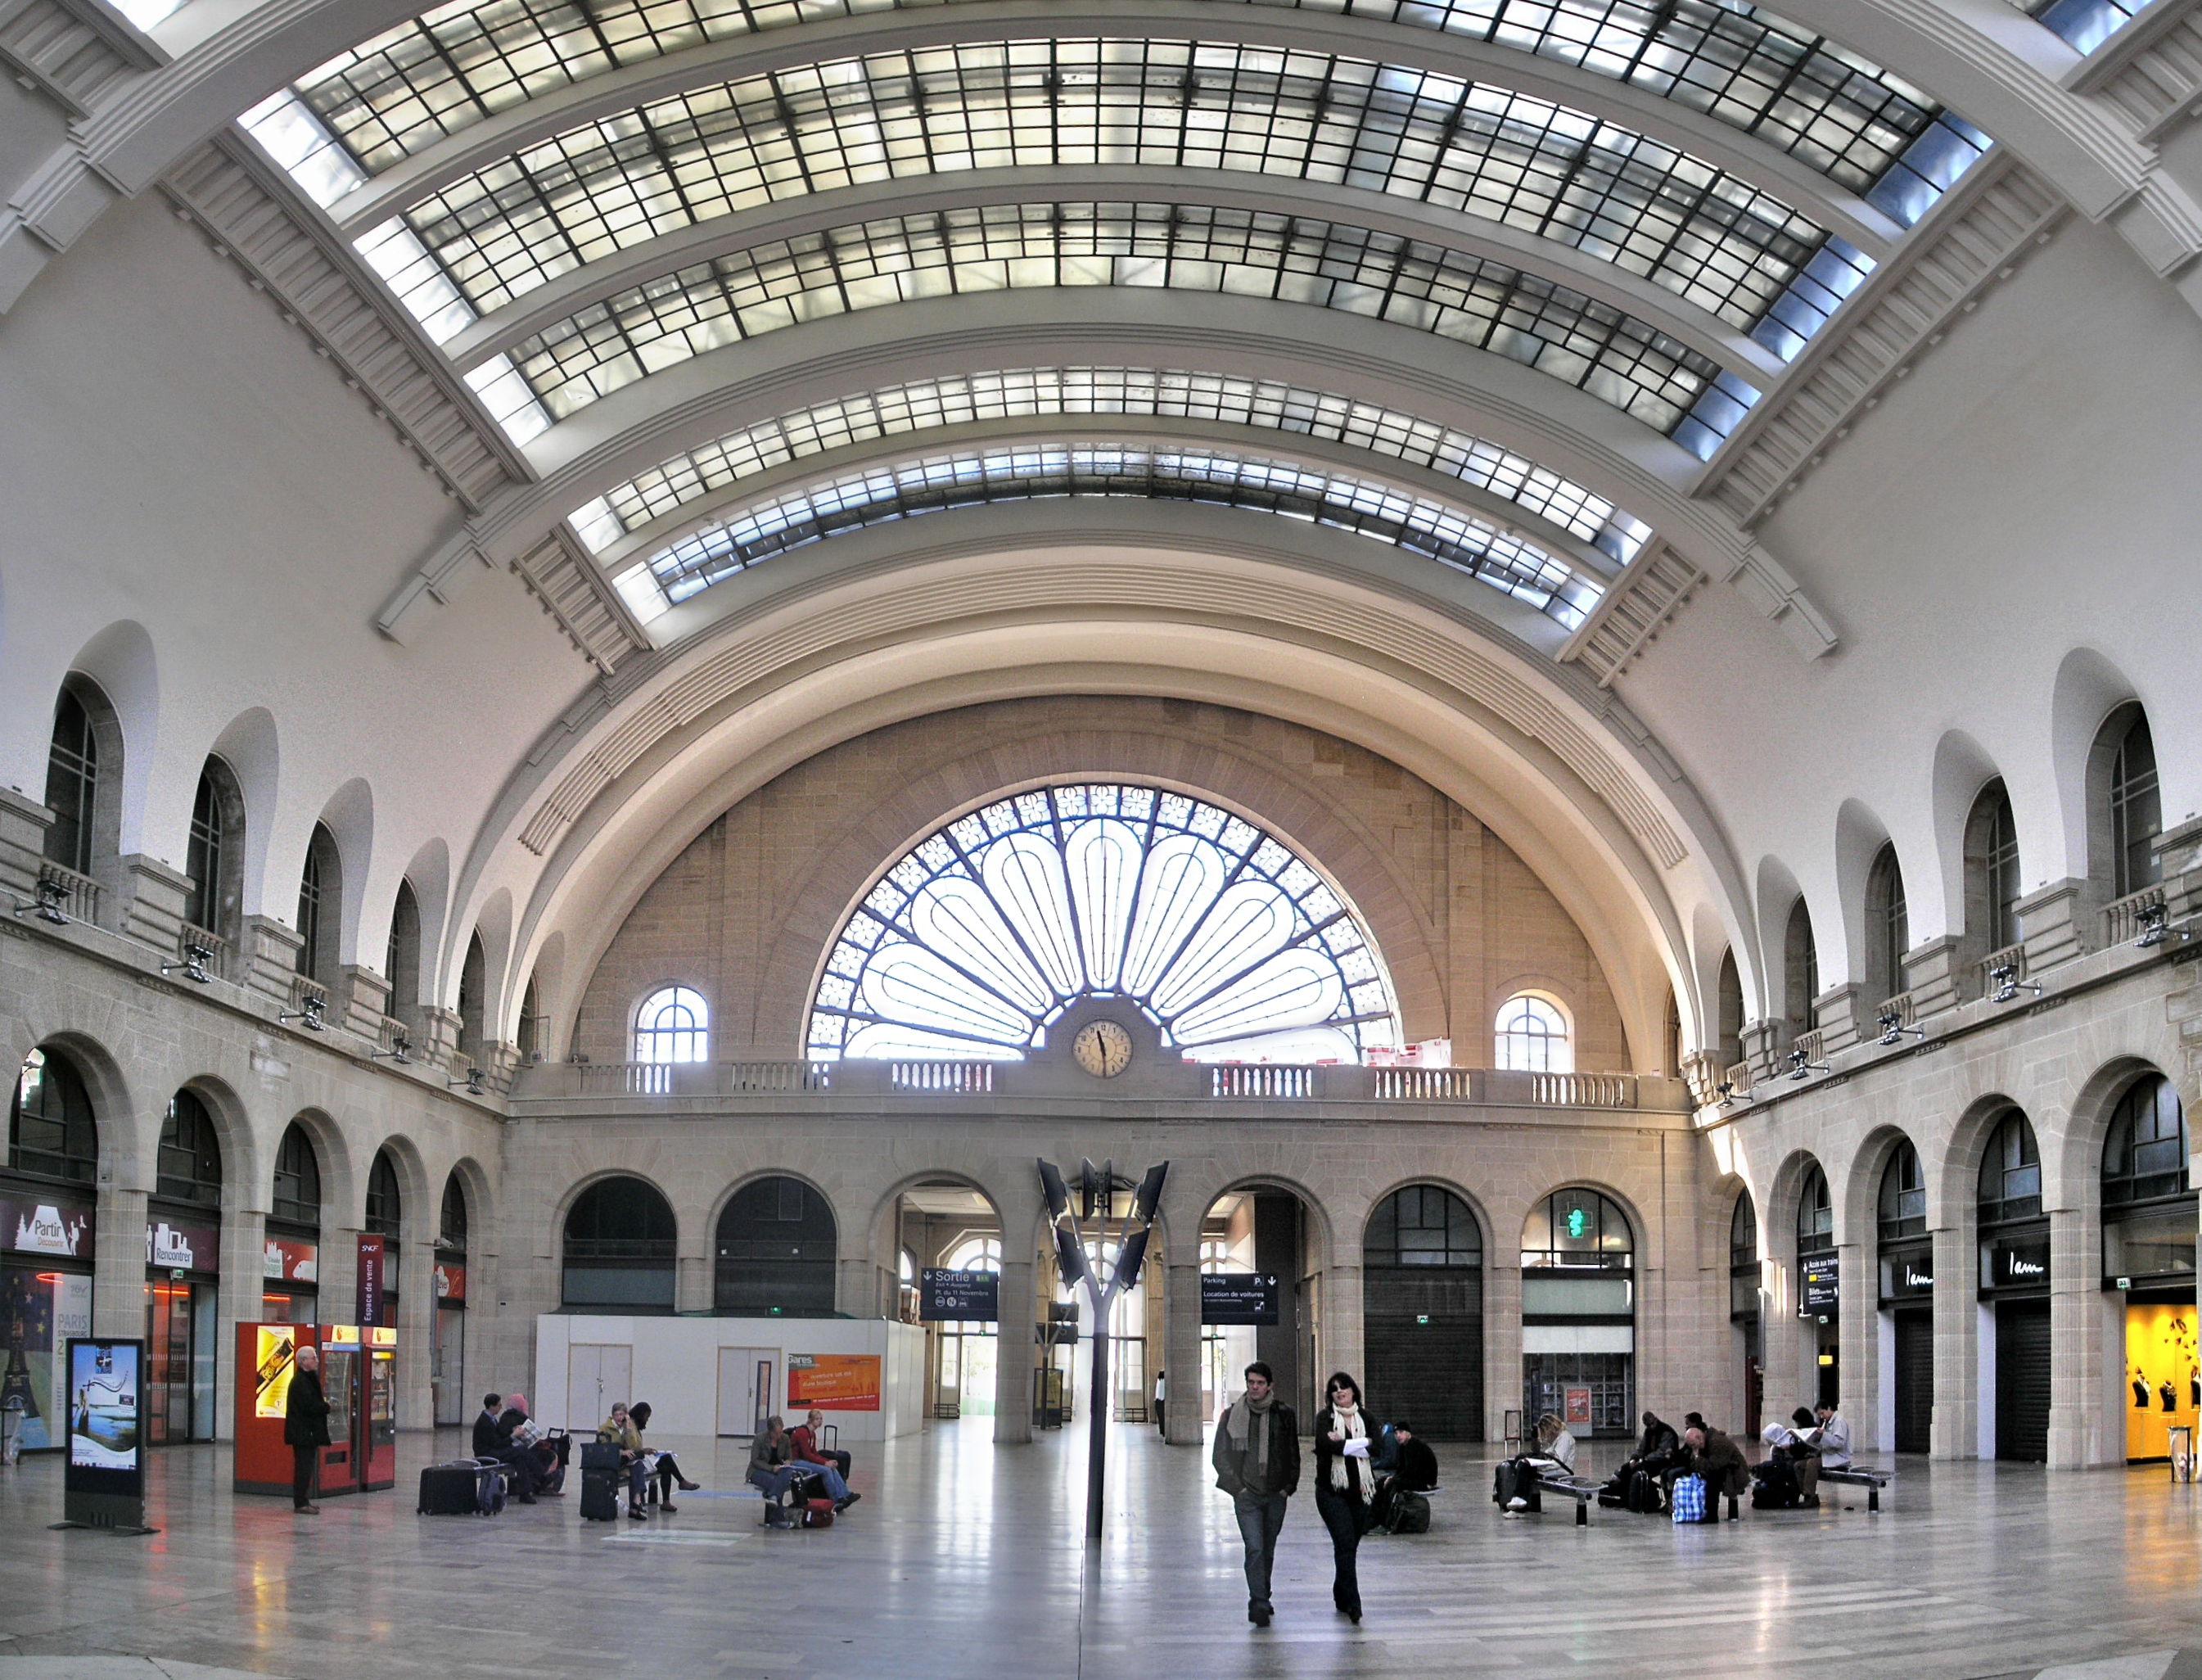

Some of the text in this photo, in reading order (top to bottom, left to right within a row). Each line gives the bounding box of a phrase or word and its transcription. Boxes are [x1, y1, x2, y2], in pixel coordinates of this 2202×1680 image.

[35, 1219, 62, 1237] Partir
[156, 1247, 192, 1262] Rencontrer
[936, 1271, 970, 1282] Sortie
[364, 1281, 372, 1293] de
[363, 1294, 373, 1322] Espace
[57, 1313, 88, 1330] PARIS
[57, 1328, 88, 1338] STRASBOURG
[788, 1354, 813, 1365] Gares
